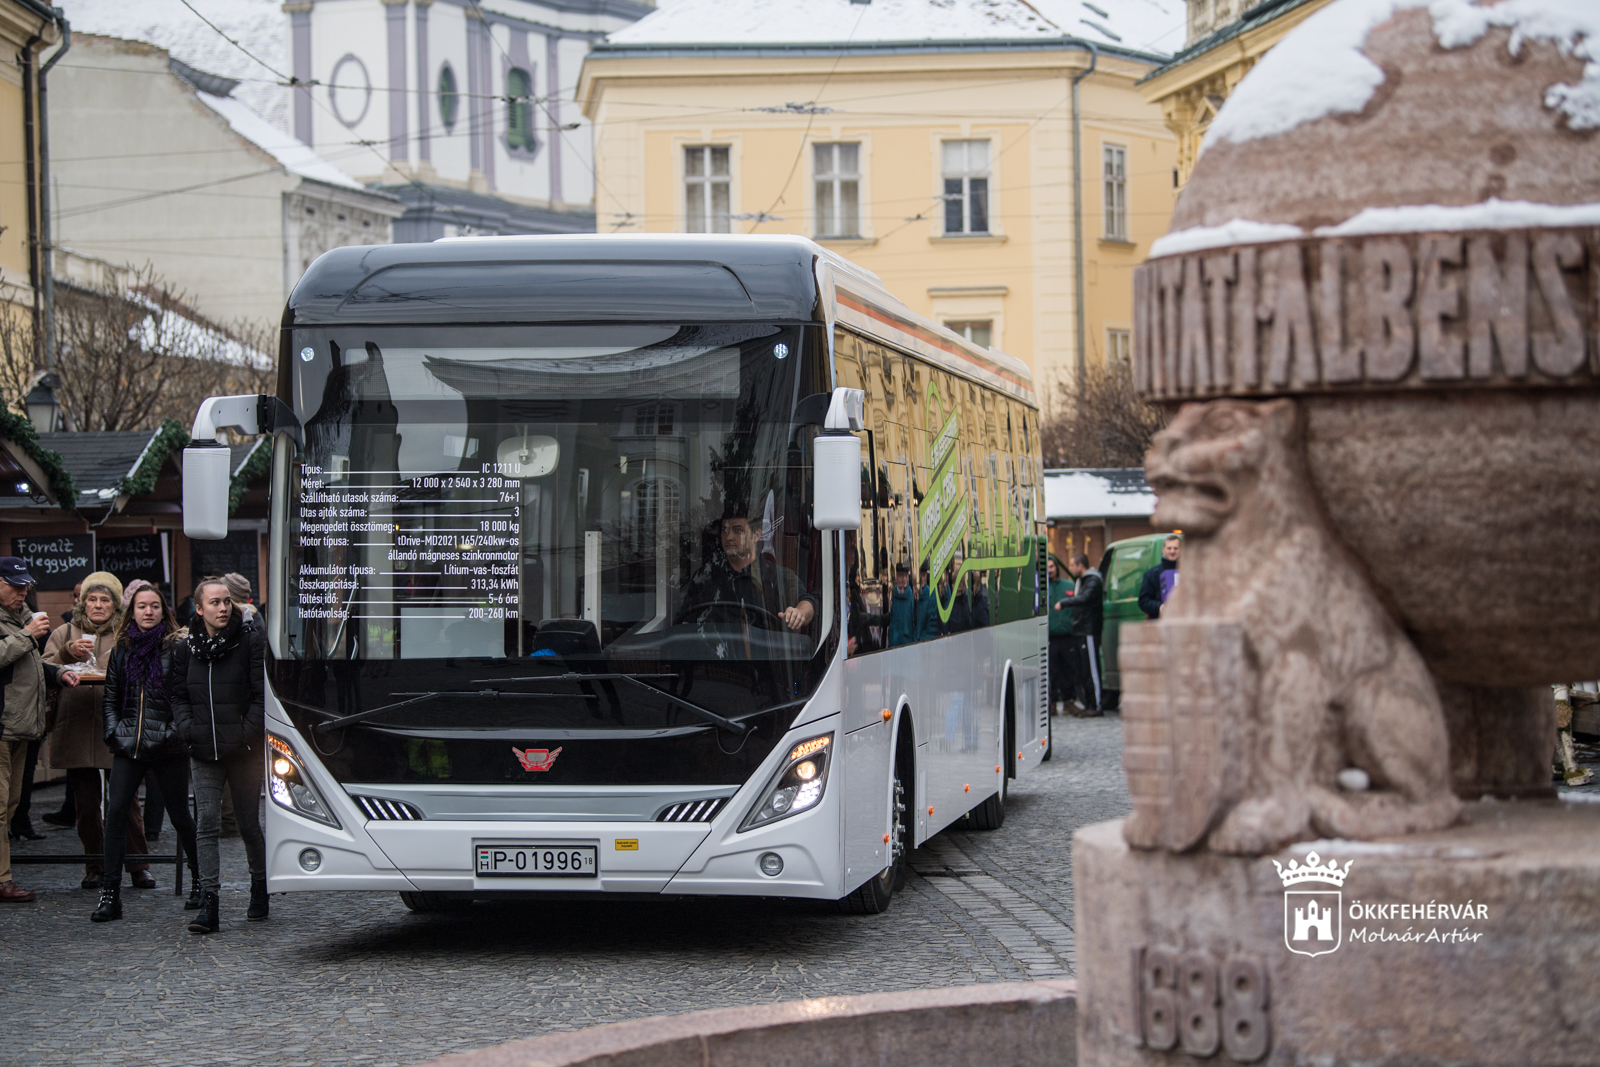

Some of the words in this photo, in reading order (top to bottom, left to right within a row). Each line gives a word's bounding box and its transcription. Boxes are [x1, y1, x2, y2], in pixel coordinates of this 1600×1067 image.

[1268, 231, 1600, 388] ALBENS
[301, 464, 322, 475] Típus:
[483, 463, 490, 473] IC
[493, 463, 512, 473] 1211
[515, 463, 520, 473] U
[301, 478, 324, 488] Méret:
[412, 478, 422, 488] 12
[424, 478, 439, 488] 000
[448, 478, 453, 487] 2
[456, 478, 470, 487] 540
[480, 478, 484, 487] 3
[488, 478, 502, 487] 280
[300, 492, 340, 503] Szállítható
[342, 492, 368, 502] utasok
[371, 493, 399, 502] száma:
[500, 492, 519, 502] 76+1
[300, 508, 316, 517] Utas
[318, 507, 338, 519] ajtók
[340, 508, 367, 517] száma:
[514, 507, 519, 516] 3
[300, 522, 348, 534] Megengedett
[351, 522, 395, 534] össztömeg:
[480, 521, 490, 531] 18
[492, 521, 507, 531] 000
[509, 521, 519, 533] kg
[300, 537, 321, 546] Motor
[323, 536, 349, 548] típusa:
[388, 550, 417, 560] állandó
[420, 551, 460, 563] mágneses
[462, 550, 519, 560] szinkronmotor
[23, 555, 88, 573] Meggybor
[299, 565, 347, 575] Akkumulátor
[349, 565, 376, 577] típusa:
[444, 564, 519, 575] Lítium-vas-foszfát
[299, 578, 359, 592] Összkapacitása:
[471, 579, 498, 591] 313,34
[501, 579, 518, 589] kWh
[299, 594, 322, 604] Töltési
[324, 593, 338, 604] idő:
[488, 594, 503, 604] 5-6
[505, 593, 518, 604] óra
[299, 608, 350, 620] Hatótávolság:
[469, 608, 503, 618] 200-260
[505, 608, 518, 618] km
[481, 861, 488, 869] H
[494, 852, 582, 870] P-01996
